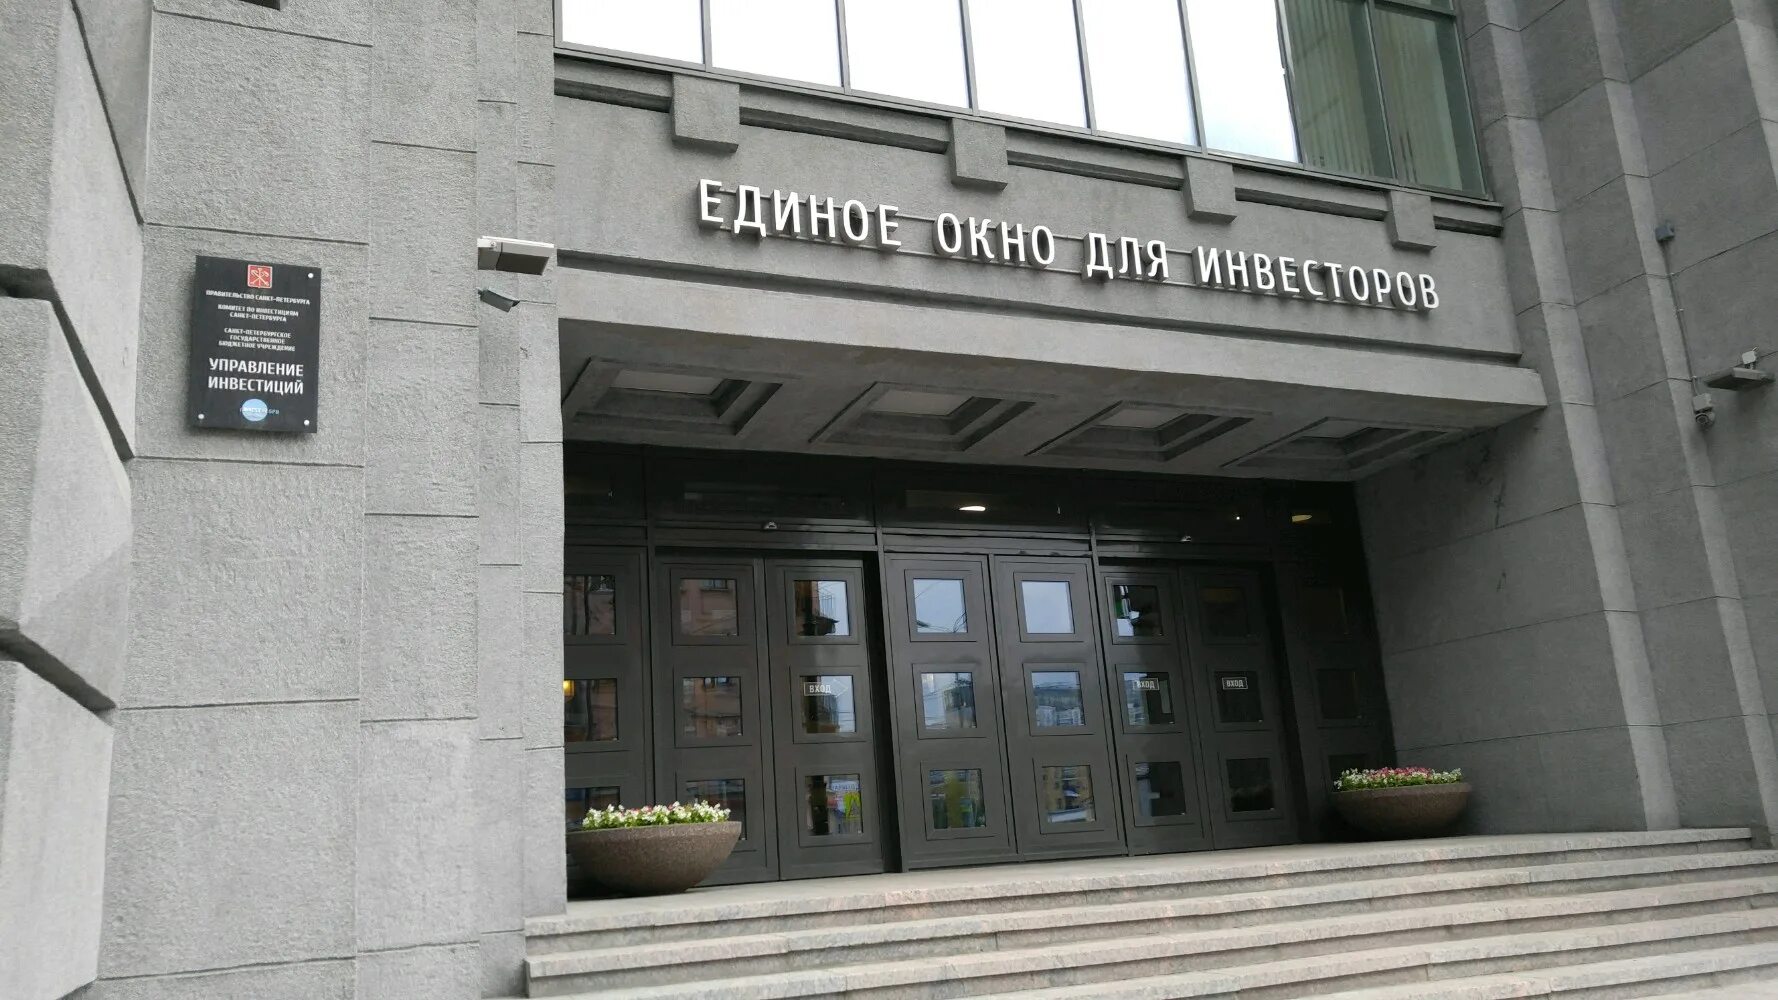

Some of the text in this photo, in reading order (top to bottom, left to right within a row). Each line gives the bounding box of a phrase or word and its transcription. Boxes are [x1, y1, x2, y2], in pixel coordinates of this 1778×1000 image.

[699, 178, 1440, 309] ЕДИНОЕ ОКНО ДЛЯ ИНВЕСТОРОВ
[206, 289, 310, 305] ПРАВИТЕЛЬСТВО САНКТ-ПЕТЕРБУРГА
[218, 304, 246, 312] КОМИТЕТ
[256, 307, 299, 317] ИНВЕСТИЦИЯМ
[229, 311, 287, 322] САНКТ-ПЕТЕРБУРГА
[224, 327, 292, 338] САНКТ-ПЕТЕРБУРГСКОЕ
[229, 334, 286, 344] ГОСУДАРСТВЕННОЕ
[218, 340, 296, 352] БЮДЖЕТНОЕ УЧРЕЖДЕНИЕ
[208, 357, 305, 377] УПРАВЛЕНИЕ
[207, 375, 305, 396] ИНВЕСТИЦИЙ
[809, 684, 832, 694] ВХОД
[1136, 680, 1156, 690] ВХОД
[1226, 679, 1245, 688] ВХОД
